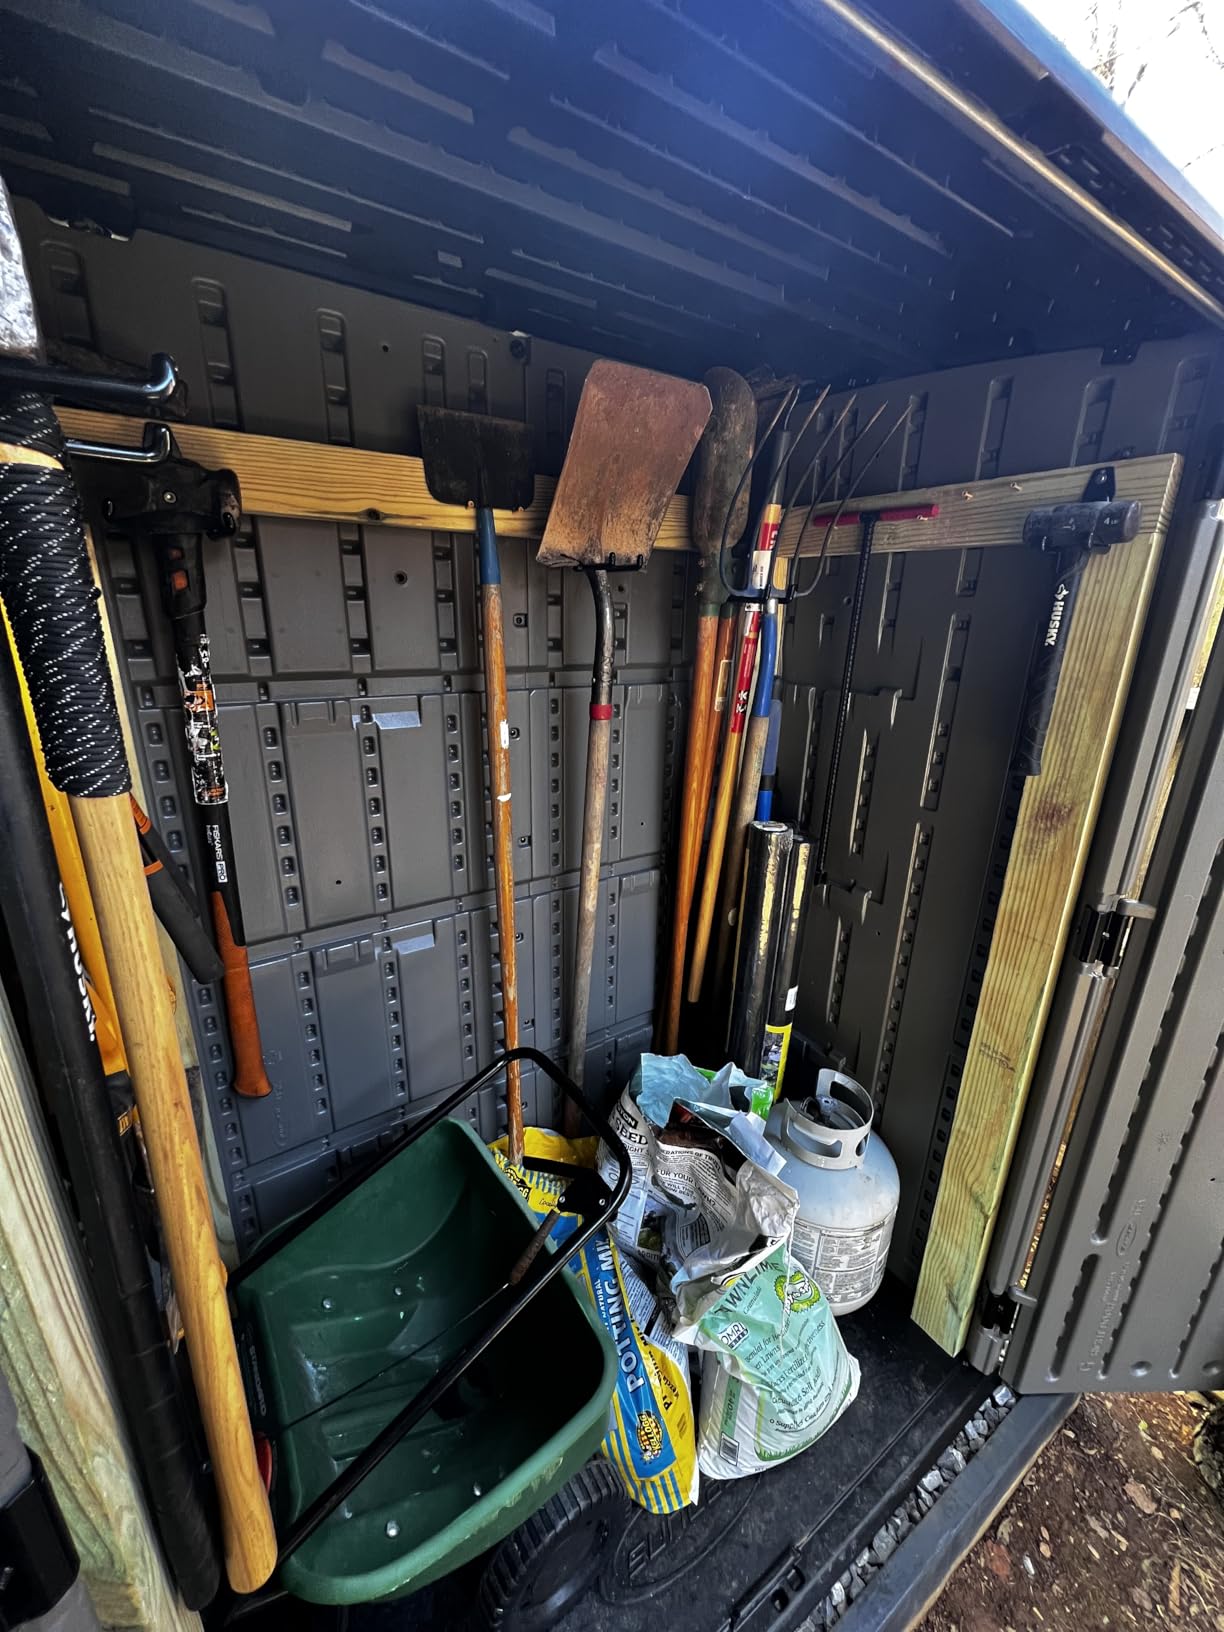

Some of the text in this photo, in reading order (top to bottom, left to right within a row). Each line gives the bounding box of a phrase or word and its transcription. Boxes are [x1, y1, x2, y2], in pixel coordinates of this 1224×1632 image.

[212, 824, 227, 882] FISKARS PRO
[613, 1118, 648, 1146] SEED
[673, 1171, 694, 1184] YOUR
[605, 1278, 645, 1393] POTTING
[721, 1322, 745, 1345] OMRI
[639, 1413, 662, 1457] KELLOGG
